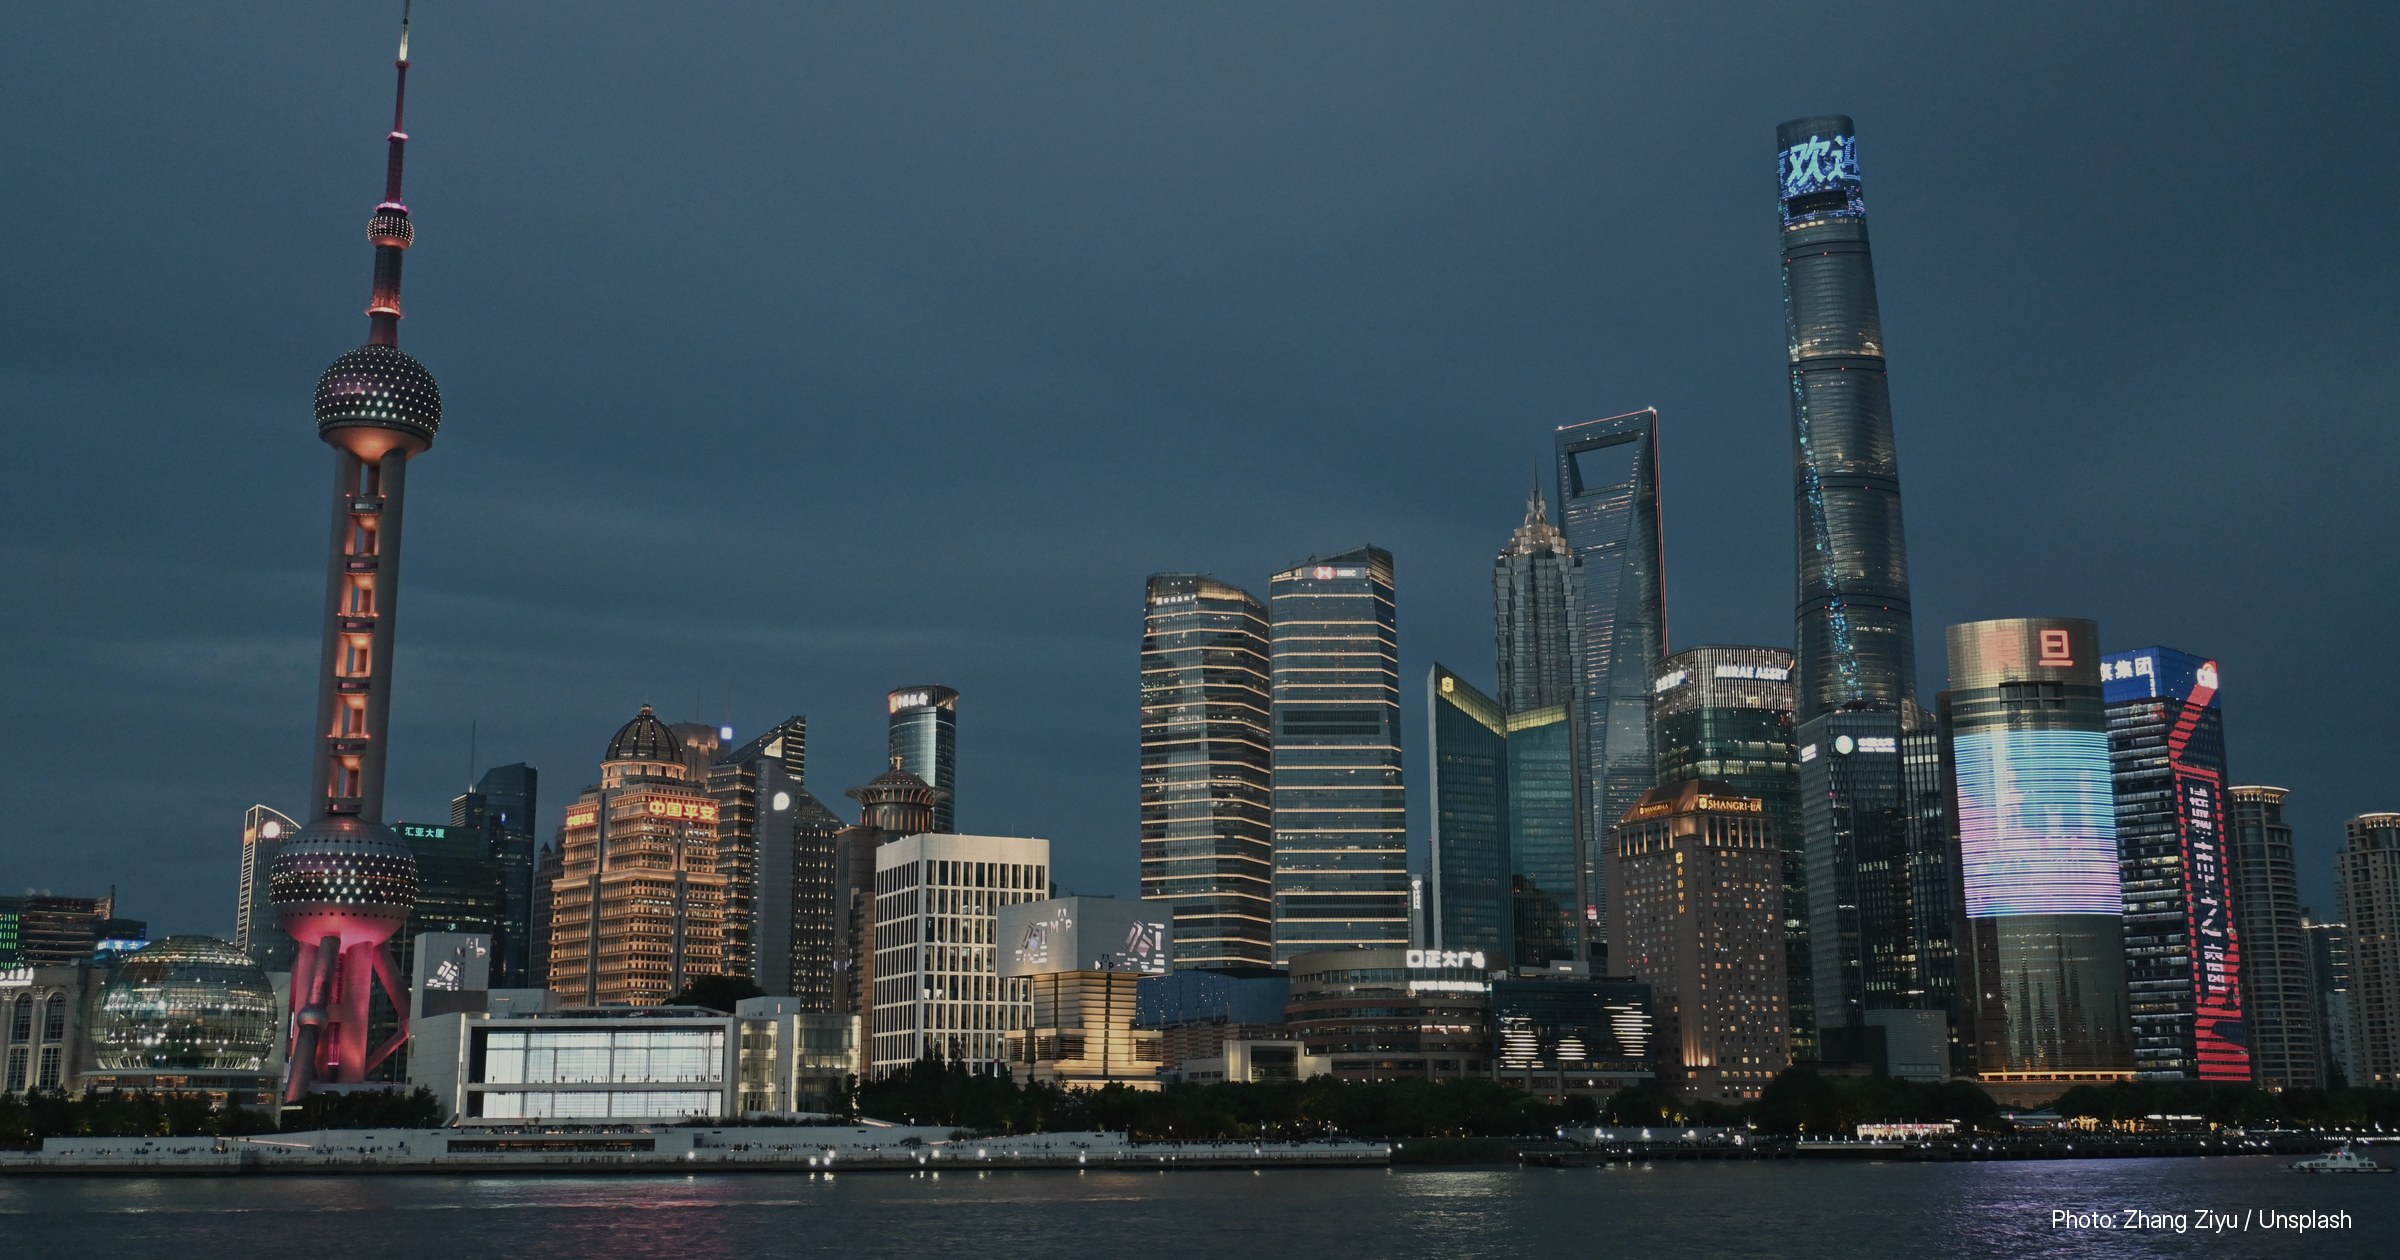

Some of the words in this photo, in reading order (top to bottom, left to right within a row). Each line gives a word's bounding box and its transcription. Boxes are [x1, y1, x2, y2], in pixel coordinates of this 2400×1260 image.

[1787, 135, 1860, 187] 欢迎
[649, 800, 716, 820] 中国平安
[1708, 799, 1762, 812] SHANGRI-LA
[566, 812, 595, 827] 中国平安
[405, 826, 445, 838] 汇亚大厦
[1425, 950, 1485, 968] 正大广场
